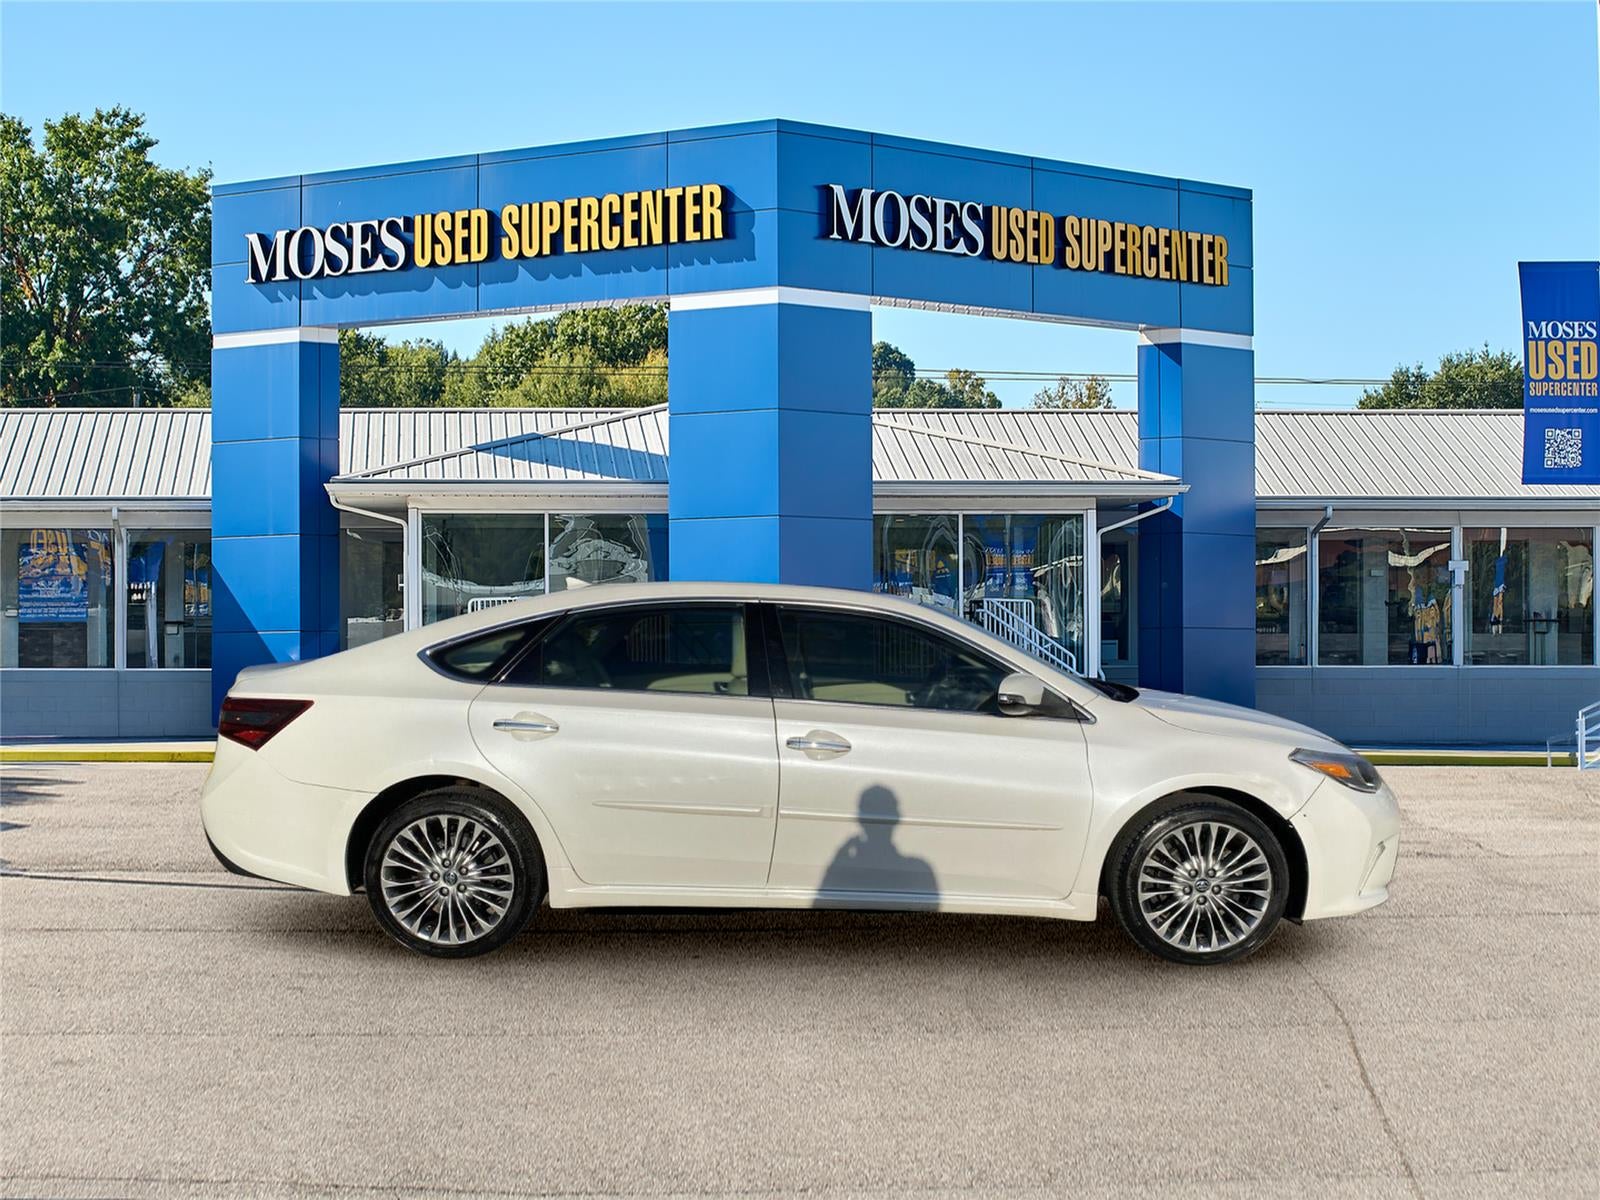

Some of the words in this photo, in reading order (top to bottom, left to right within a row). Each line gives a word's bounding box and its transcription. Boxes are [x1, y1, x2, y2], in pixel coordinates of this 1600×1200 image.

[245, 218, 408, 284] MOSES
[412, 208, 489, 268] USED
[501, 184, 724, 259] SUPERCENTER
[829, 183, 985, 257] MOSES
[991, 205, 1055, 265] USED
[1065, 216, 1229, 286] SUPERCENTER
[1527, 321, 1597, 338] MOSES
[1528, 341, 1598, 380] USED
[1529, 382, 1598, 397] SUPERCENTER
